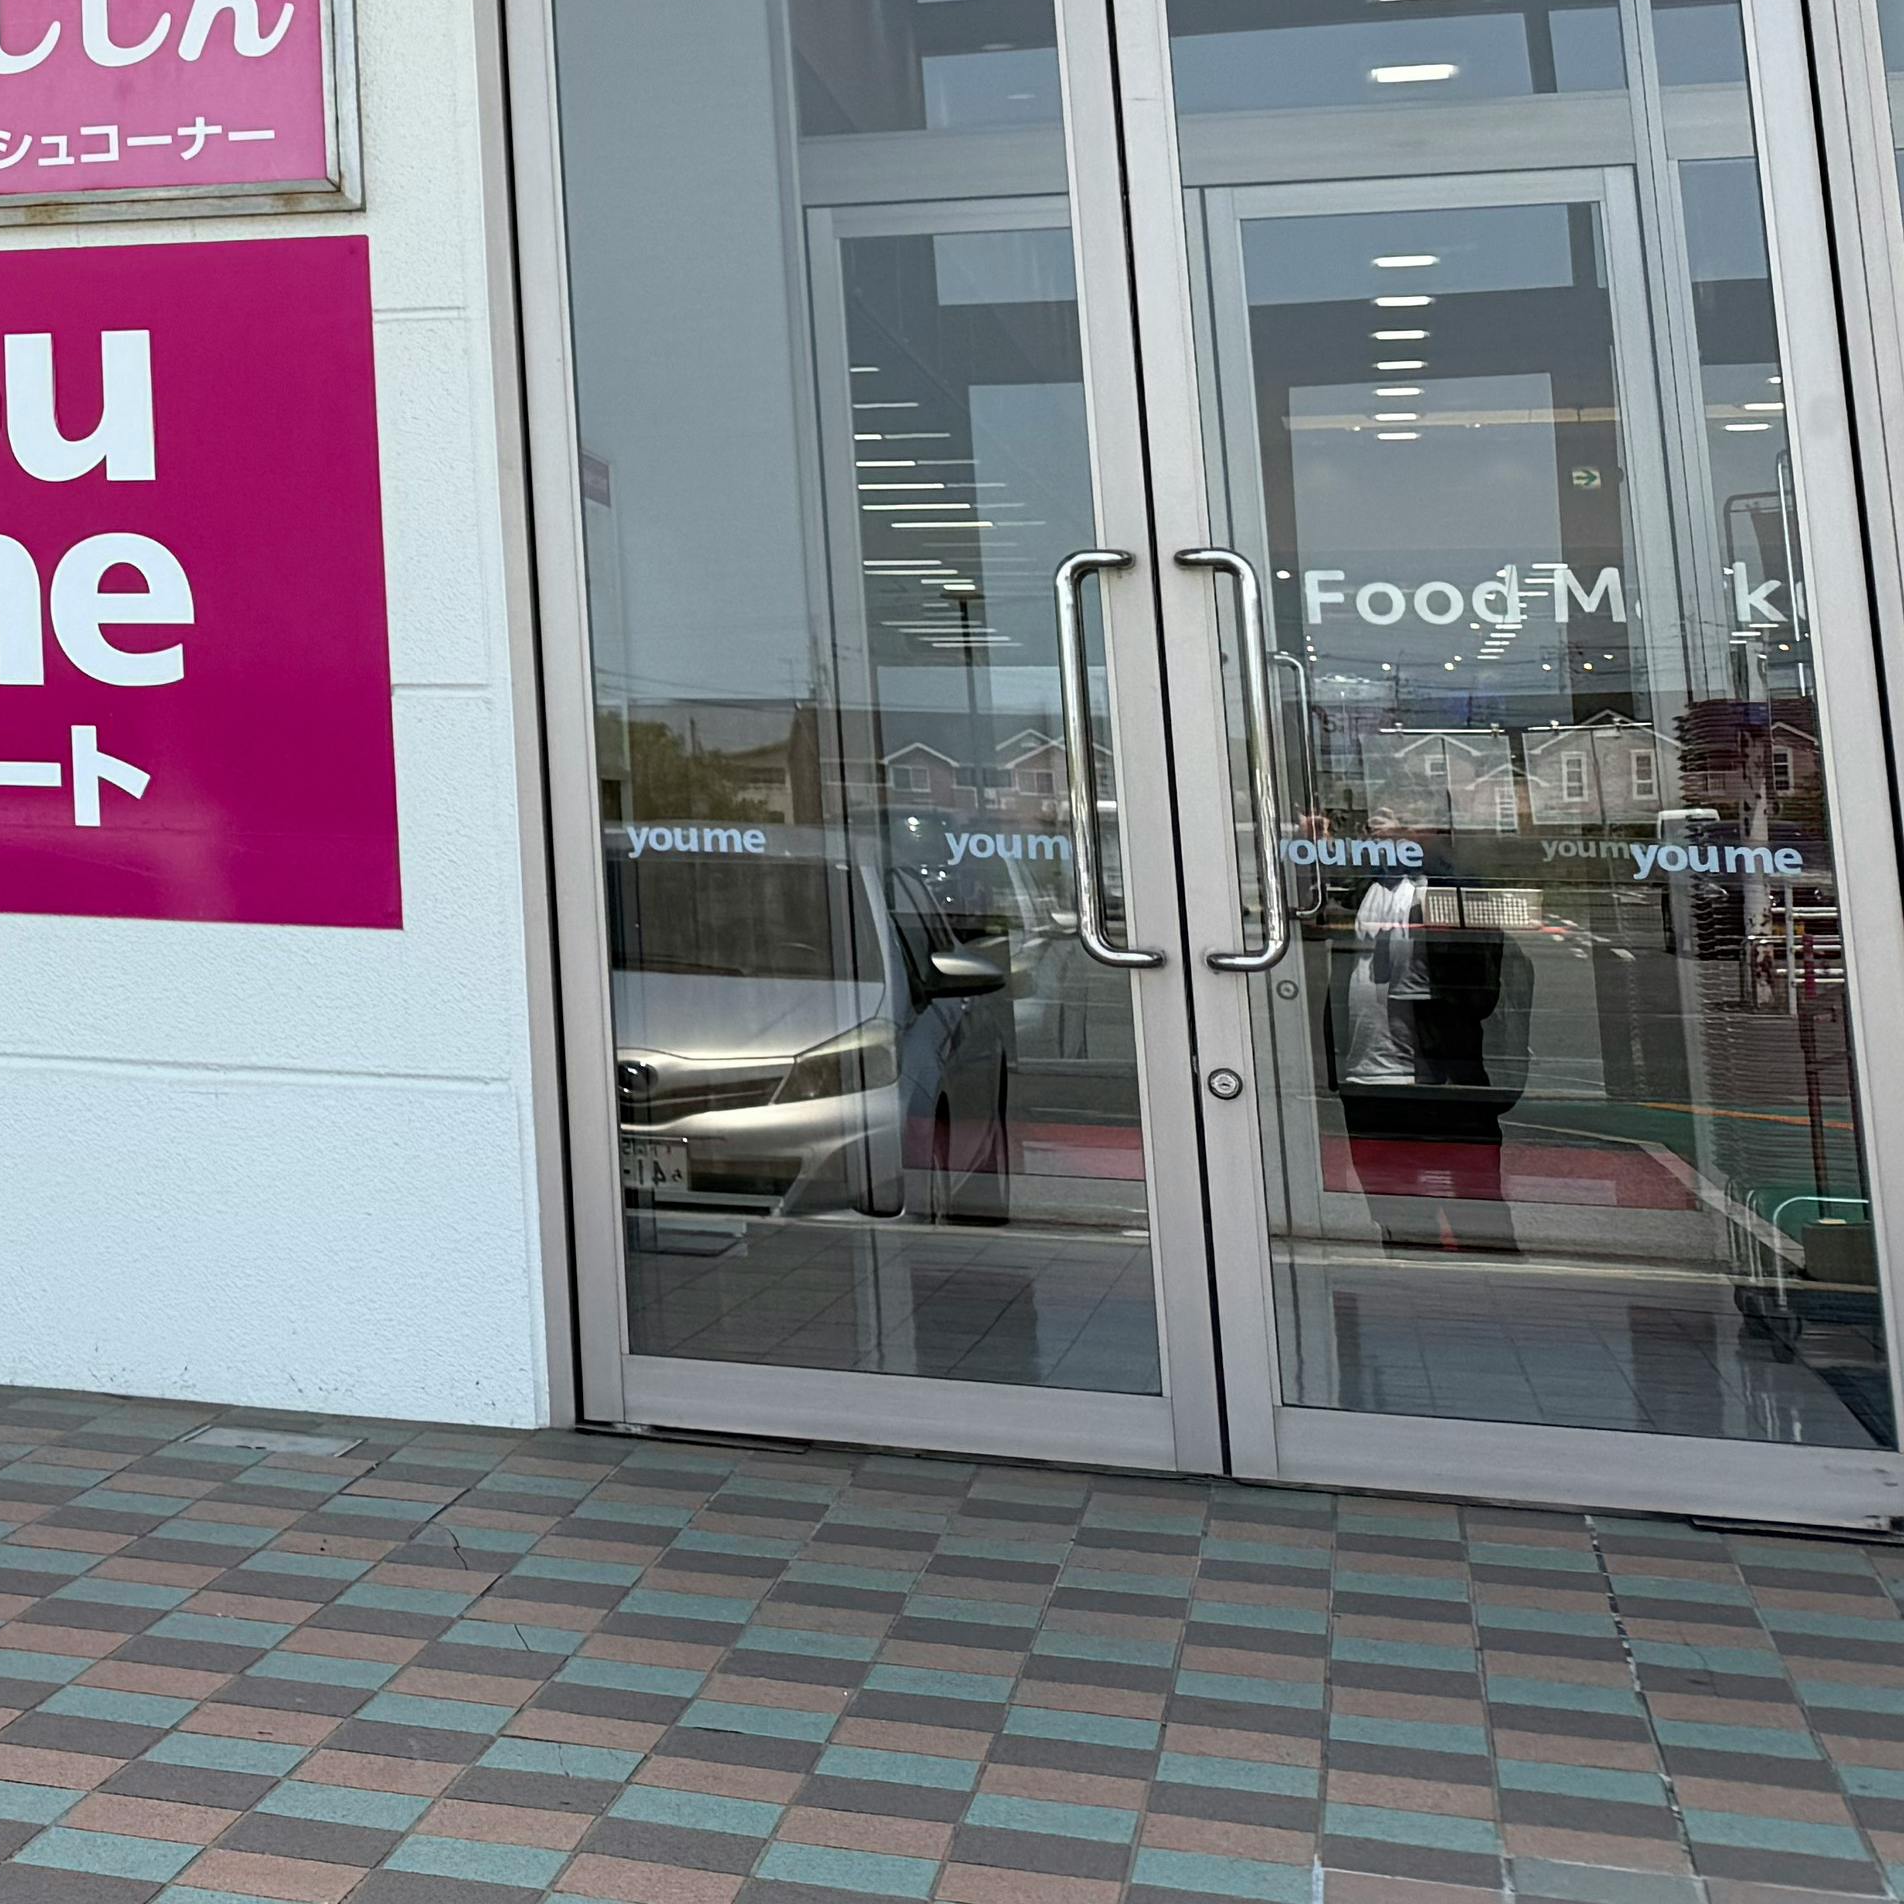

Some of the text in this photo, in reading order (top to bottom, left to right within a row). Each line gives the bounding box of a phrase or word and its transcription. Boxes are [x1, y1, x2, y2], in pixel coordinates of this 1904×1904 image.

[1304, 564, 1522, 626] Food
[944, 832, 1074, 866] youm
[1540, 839, 1647, 863] youm
